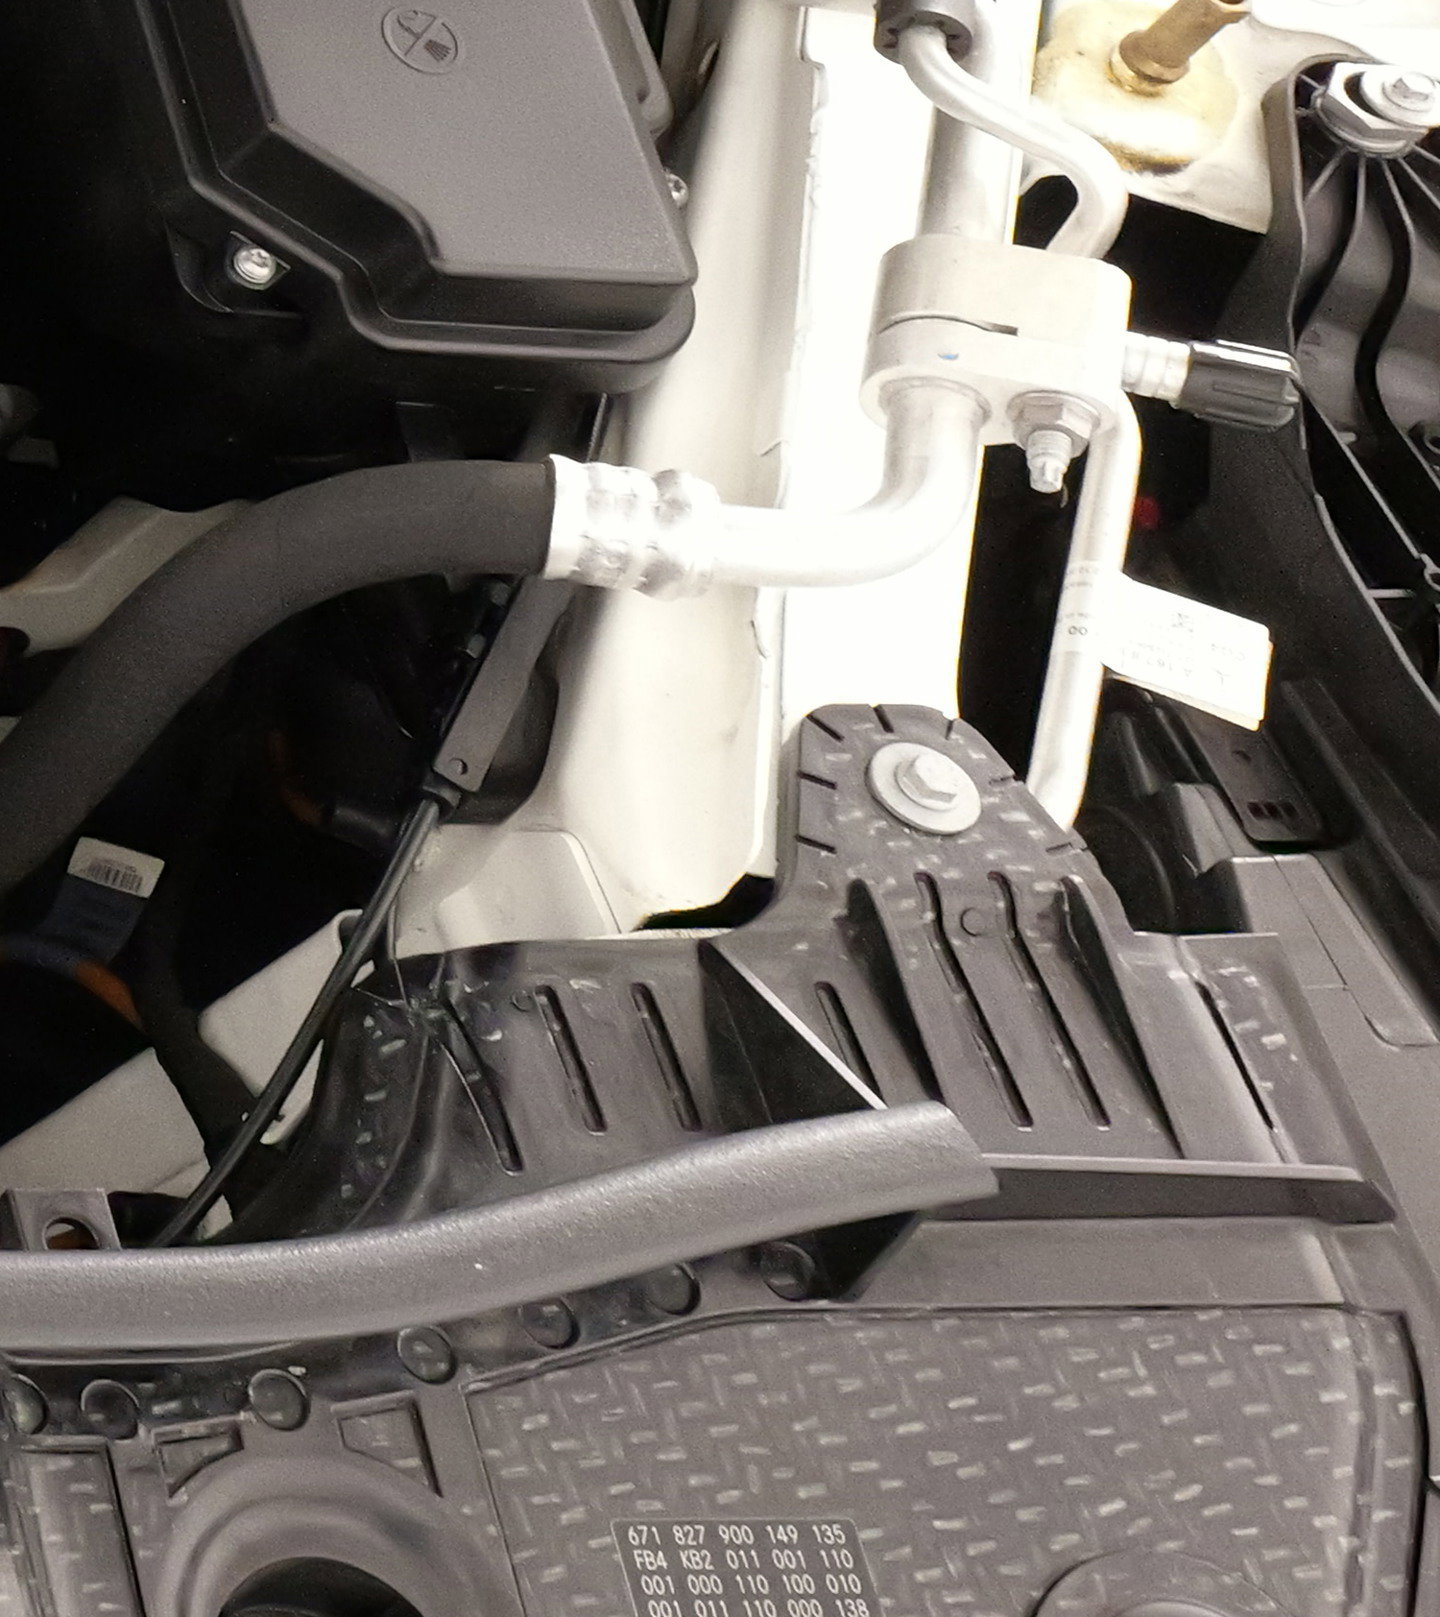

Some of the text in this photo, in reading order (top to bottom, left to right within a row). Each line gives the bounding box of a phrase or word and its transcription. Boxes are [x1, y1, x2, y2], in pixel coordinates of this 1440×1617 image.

[628, 1524, 846, 1545] 671 827 900 149 135
[633, 1550, 854, 1571] FB4 KB2 011 001 110
[640, 1574, 862, 1596] 001 000 110 100 010
[647, 1599, 870, 1617] 001 011 110 000 138
